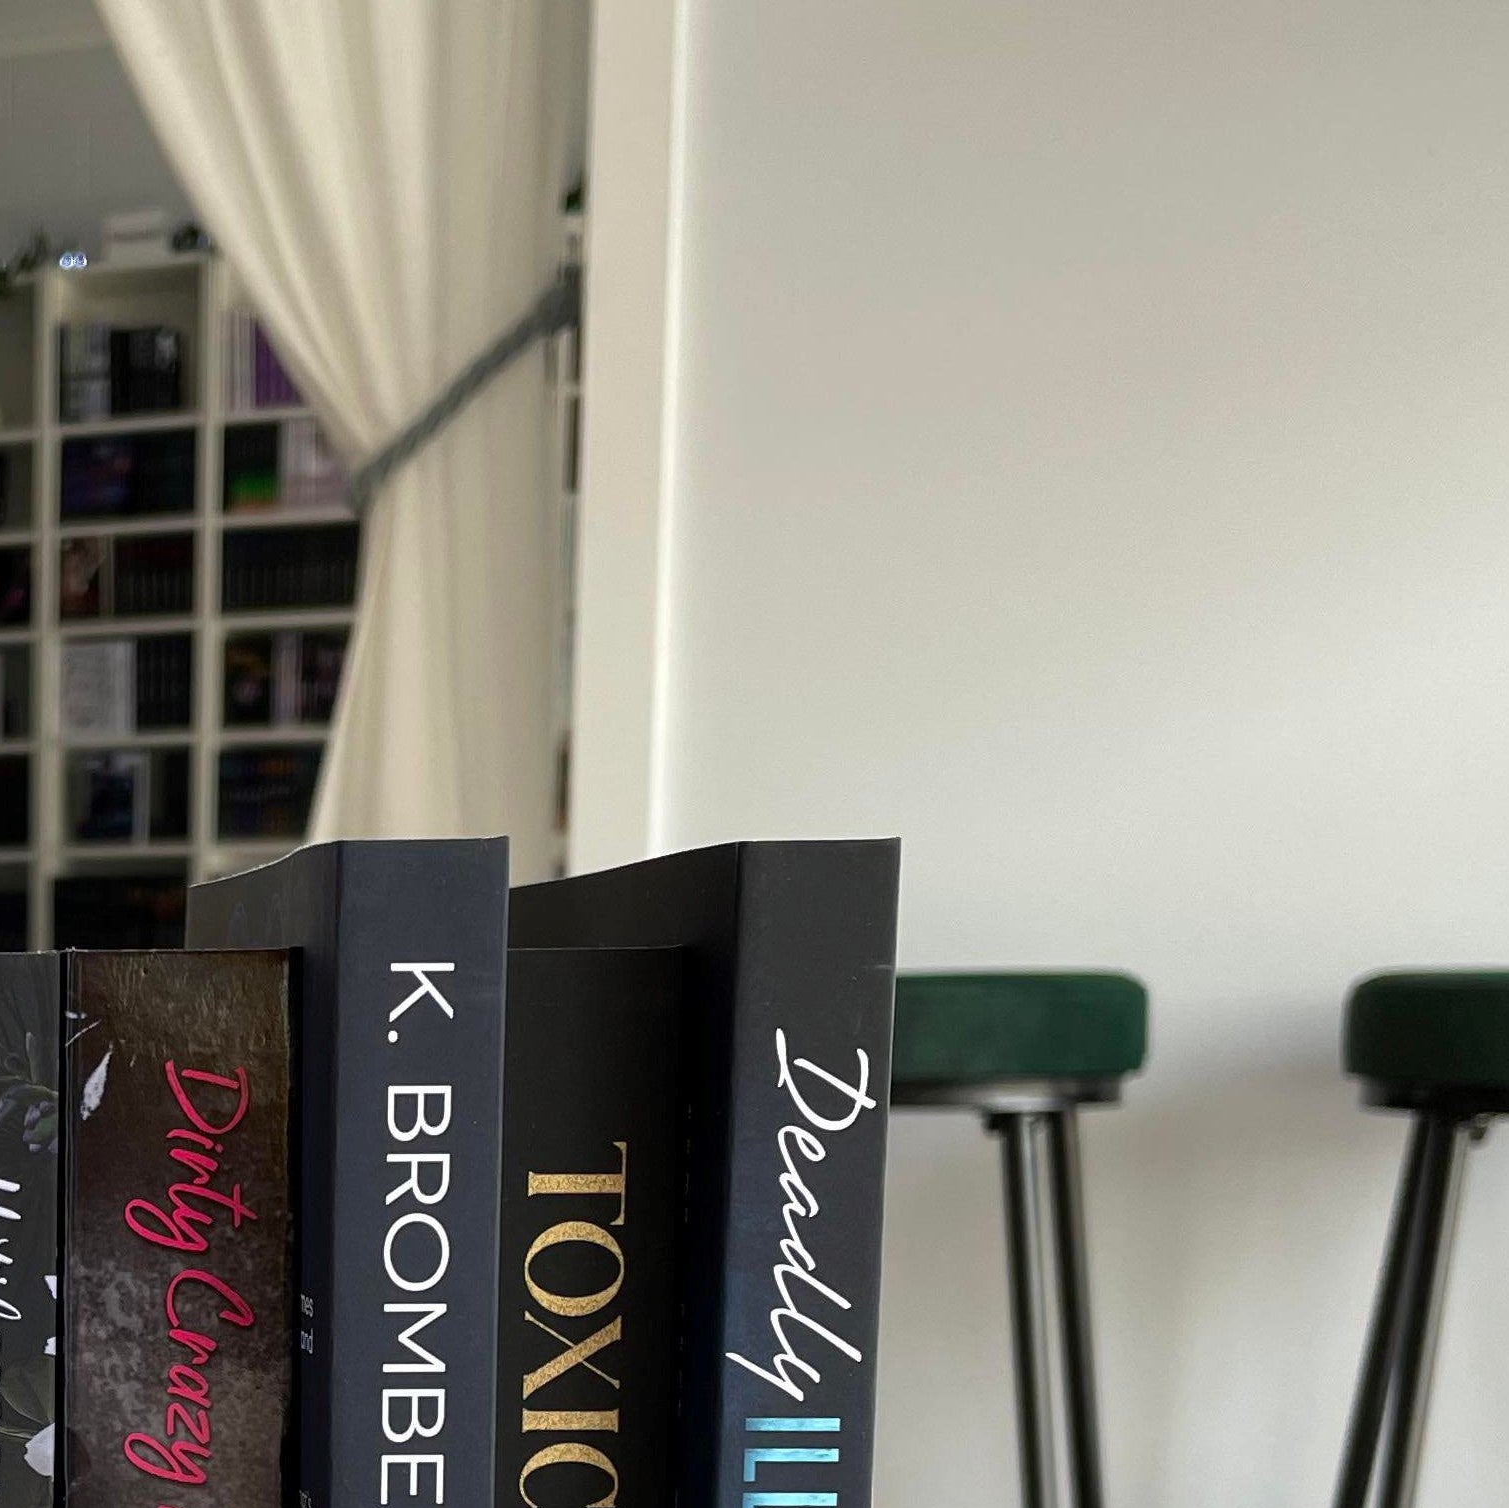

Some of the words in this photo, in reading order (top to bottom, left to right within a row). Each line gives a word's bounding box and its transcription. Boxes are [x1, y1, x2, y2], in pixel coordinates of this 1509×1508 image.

[387, 961, 456, 1045] K.
[124, 1060, 257, 1253] Dirty
[724, 1027, 878, 1402] Deadly
[124, 1269, 255, 1486] Crazy
